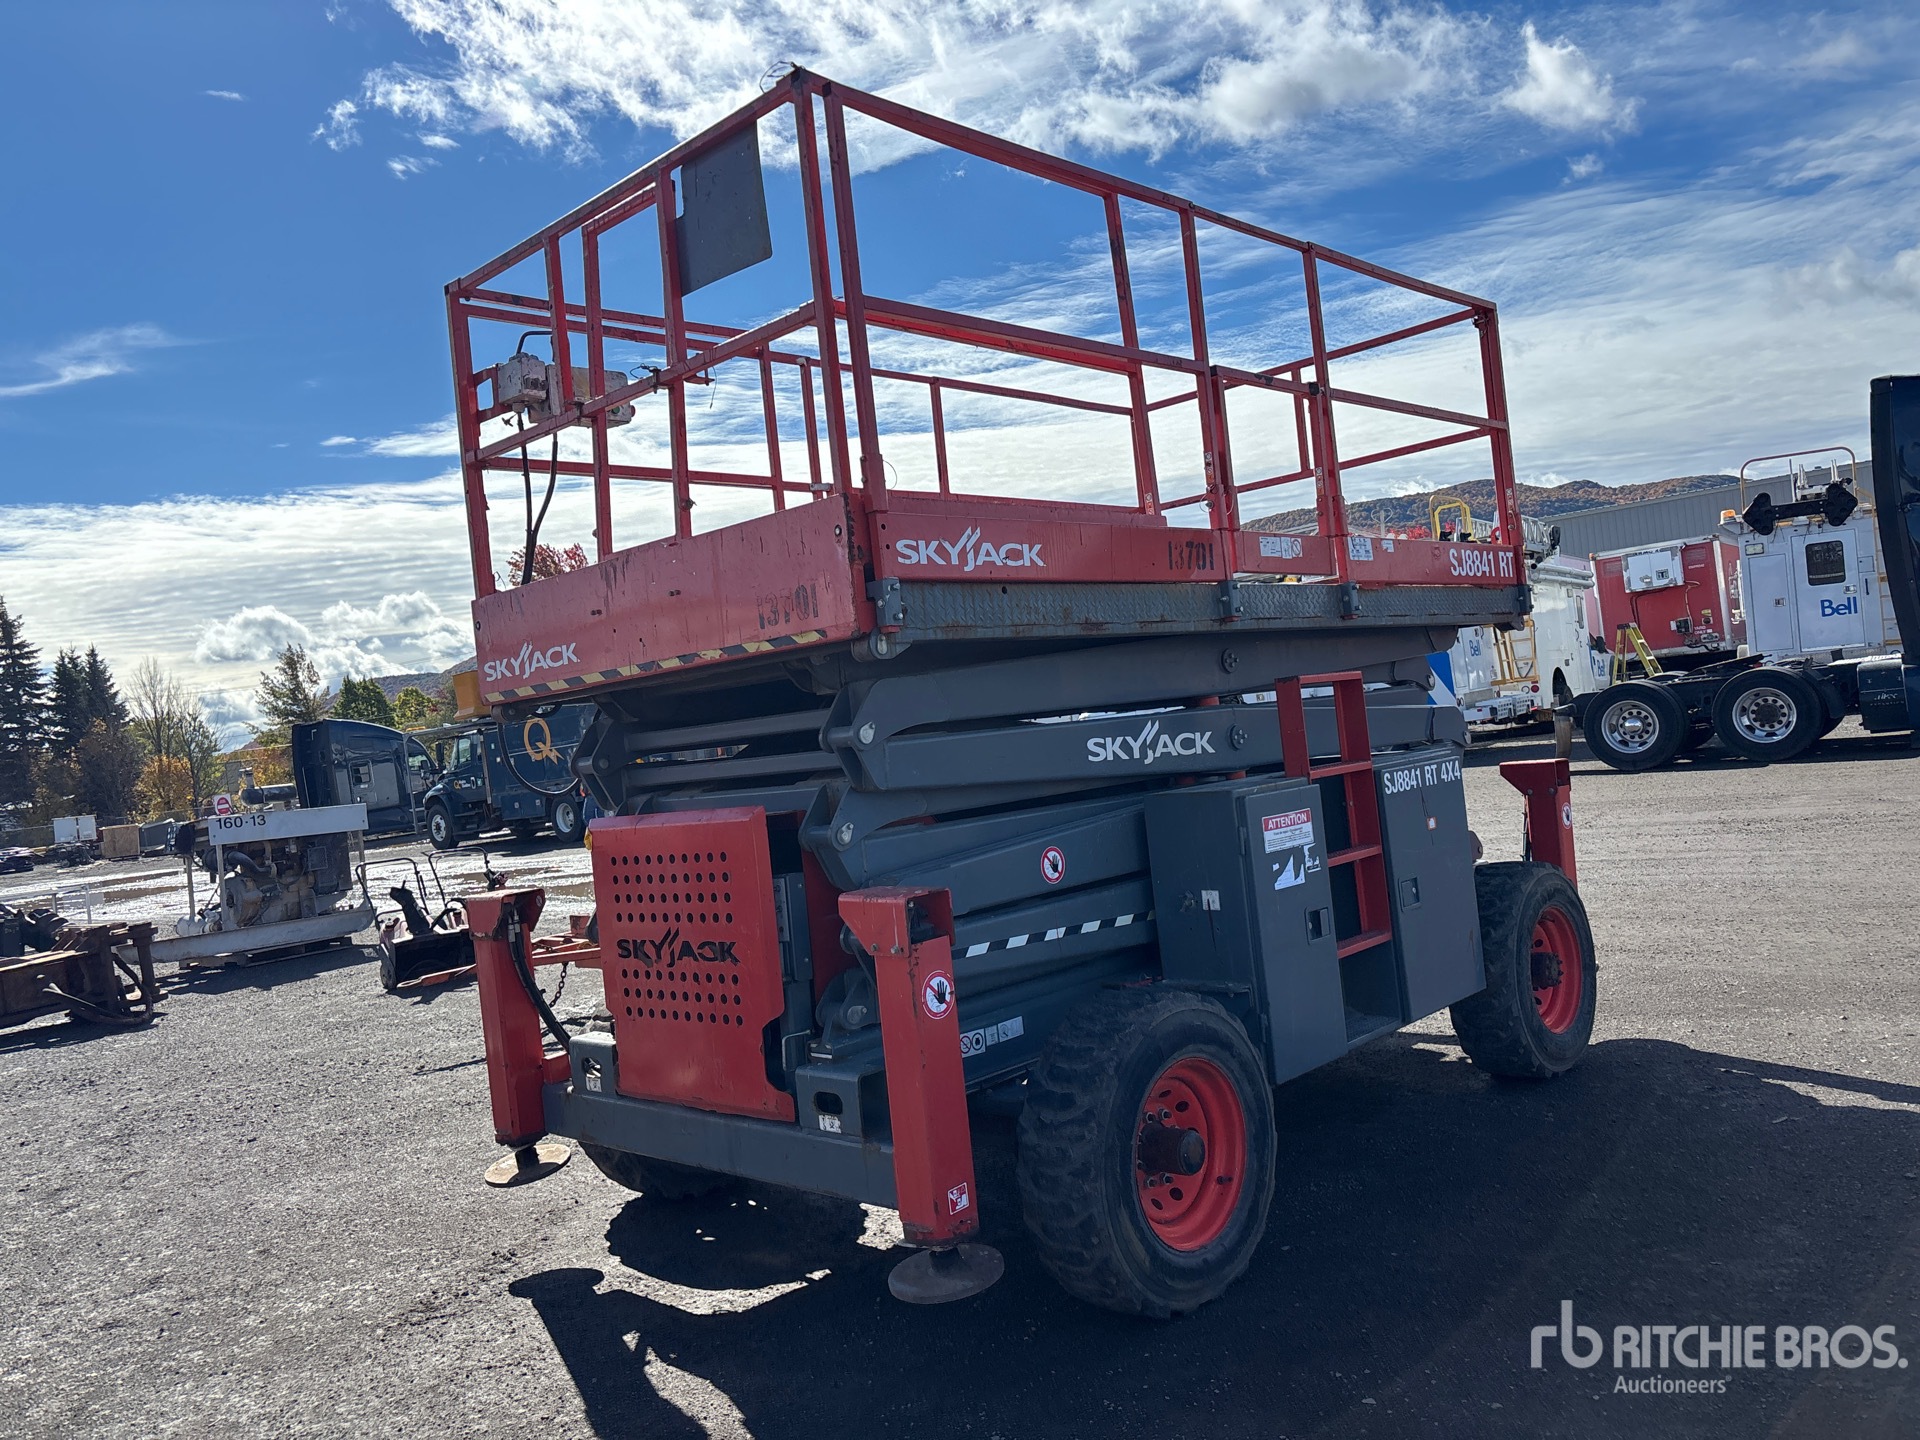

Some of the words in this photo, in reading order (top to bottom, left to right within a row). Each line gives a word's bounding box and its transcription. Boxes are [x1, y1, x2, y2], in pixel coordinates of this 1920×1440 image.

[895, 526, 1046, 572] SKYJACK
[1449, 548, 1496, 577] SJ8841
[1498, 551, 1514, 578] RT
[1820, 596, 1858, 617] Bell
[483, 641, 580, 681] SKYJACK
[1468, 639, 1482, 657] Bell
[523, 717, 565, 765] Q
[1086, 719, 1216, 765] SKYJACK
[1383, 767, 1422, 795] SJ8841
[1424, 764, 1438, 786] RT
[1440, 760, 1461, 783] 4X4
[1268, 812, 1308, 830] ATTENTION
[616, 927, 741, 968] SKYJACK
